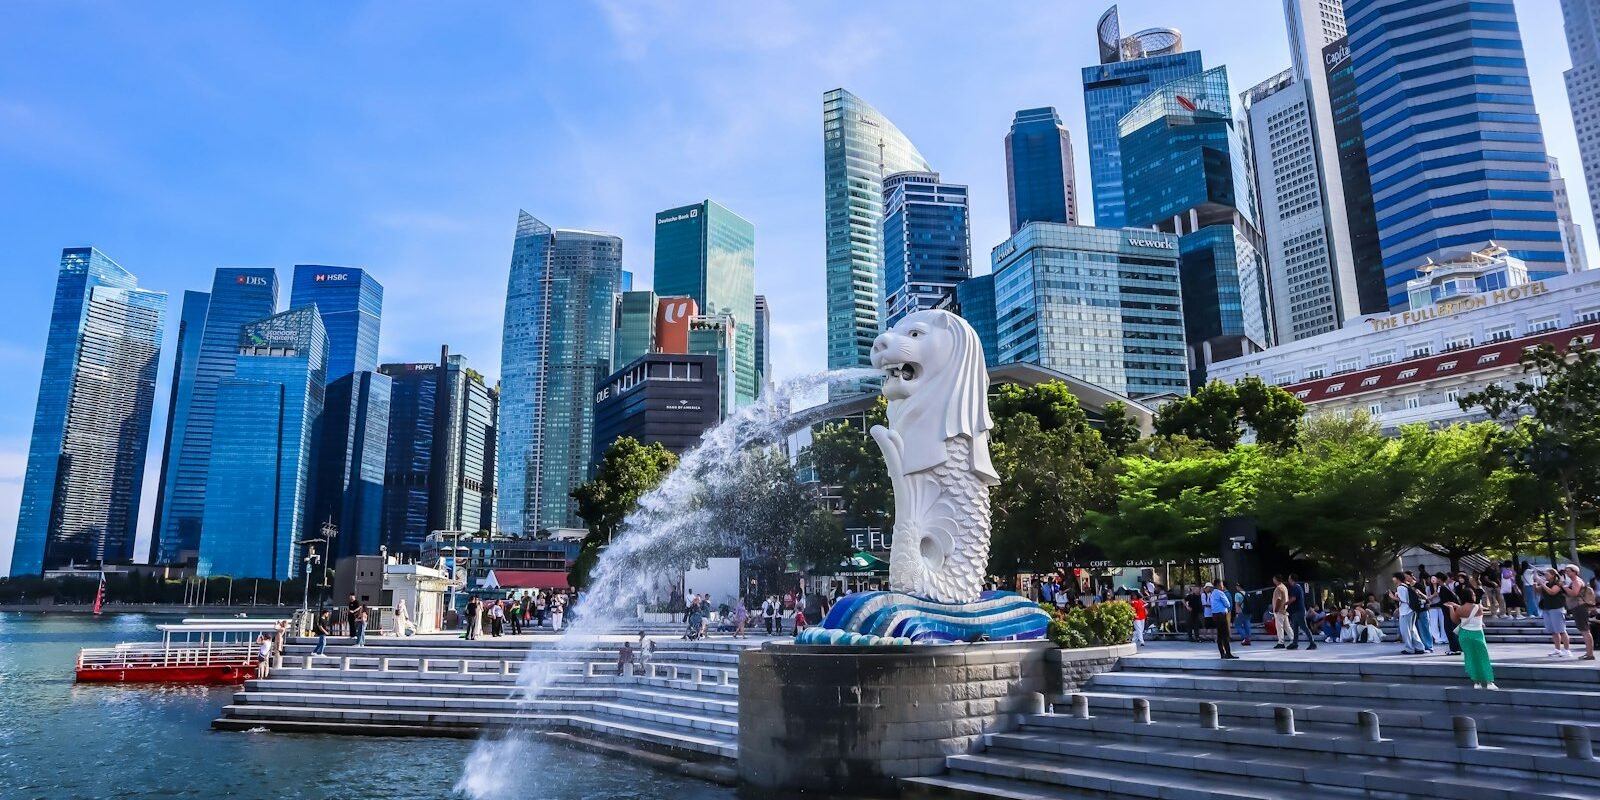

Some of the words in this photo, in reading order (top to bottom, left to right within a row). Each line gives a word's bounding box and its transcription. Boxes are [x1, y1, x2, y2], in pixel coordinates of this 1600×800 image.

[1129, 237, 1172, 249] wework
[246, 276, 267, 285] DBS
[1372, 318, 1398, 331] THE
[1403, 295, 1487, 324] FULLERTON
[1493, 281, 1549, 304] HOTEL
[596, 387, 610, 404] OUE
